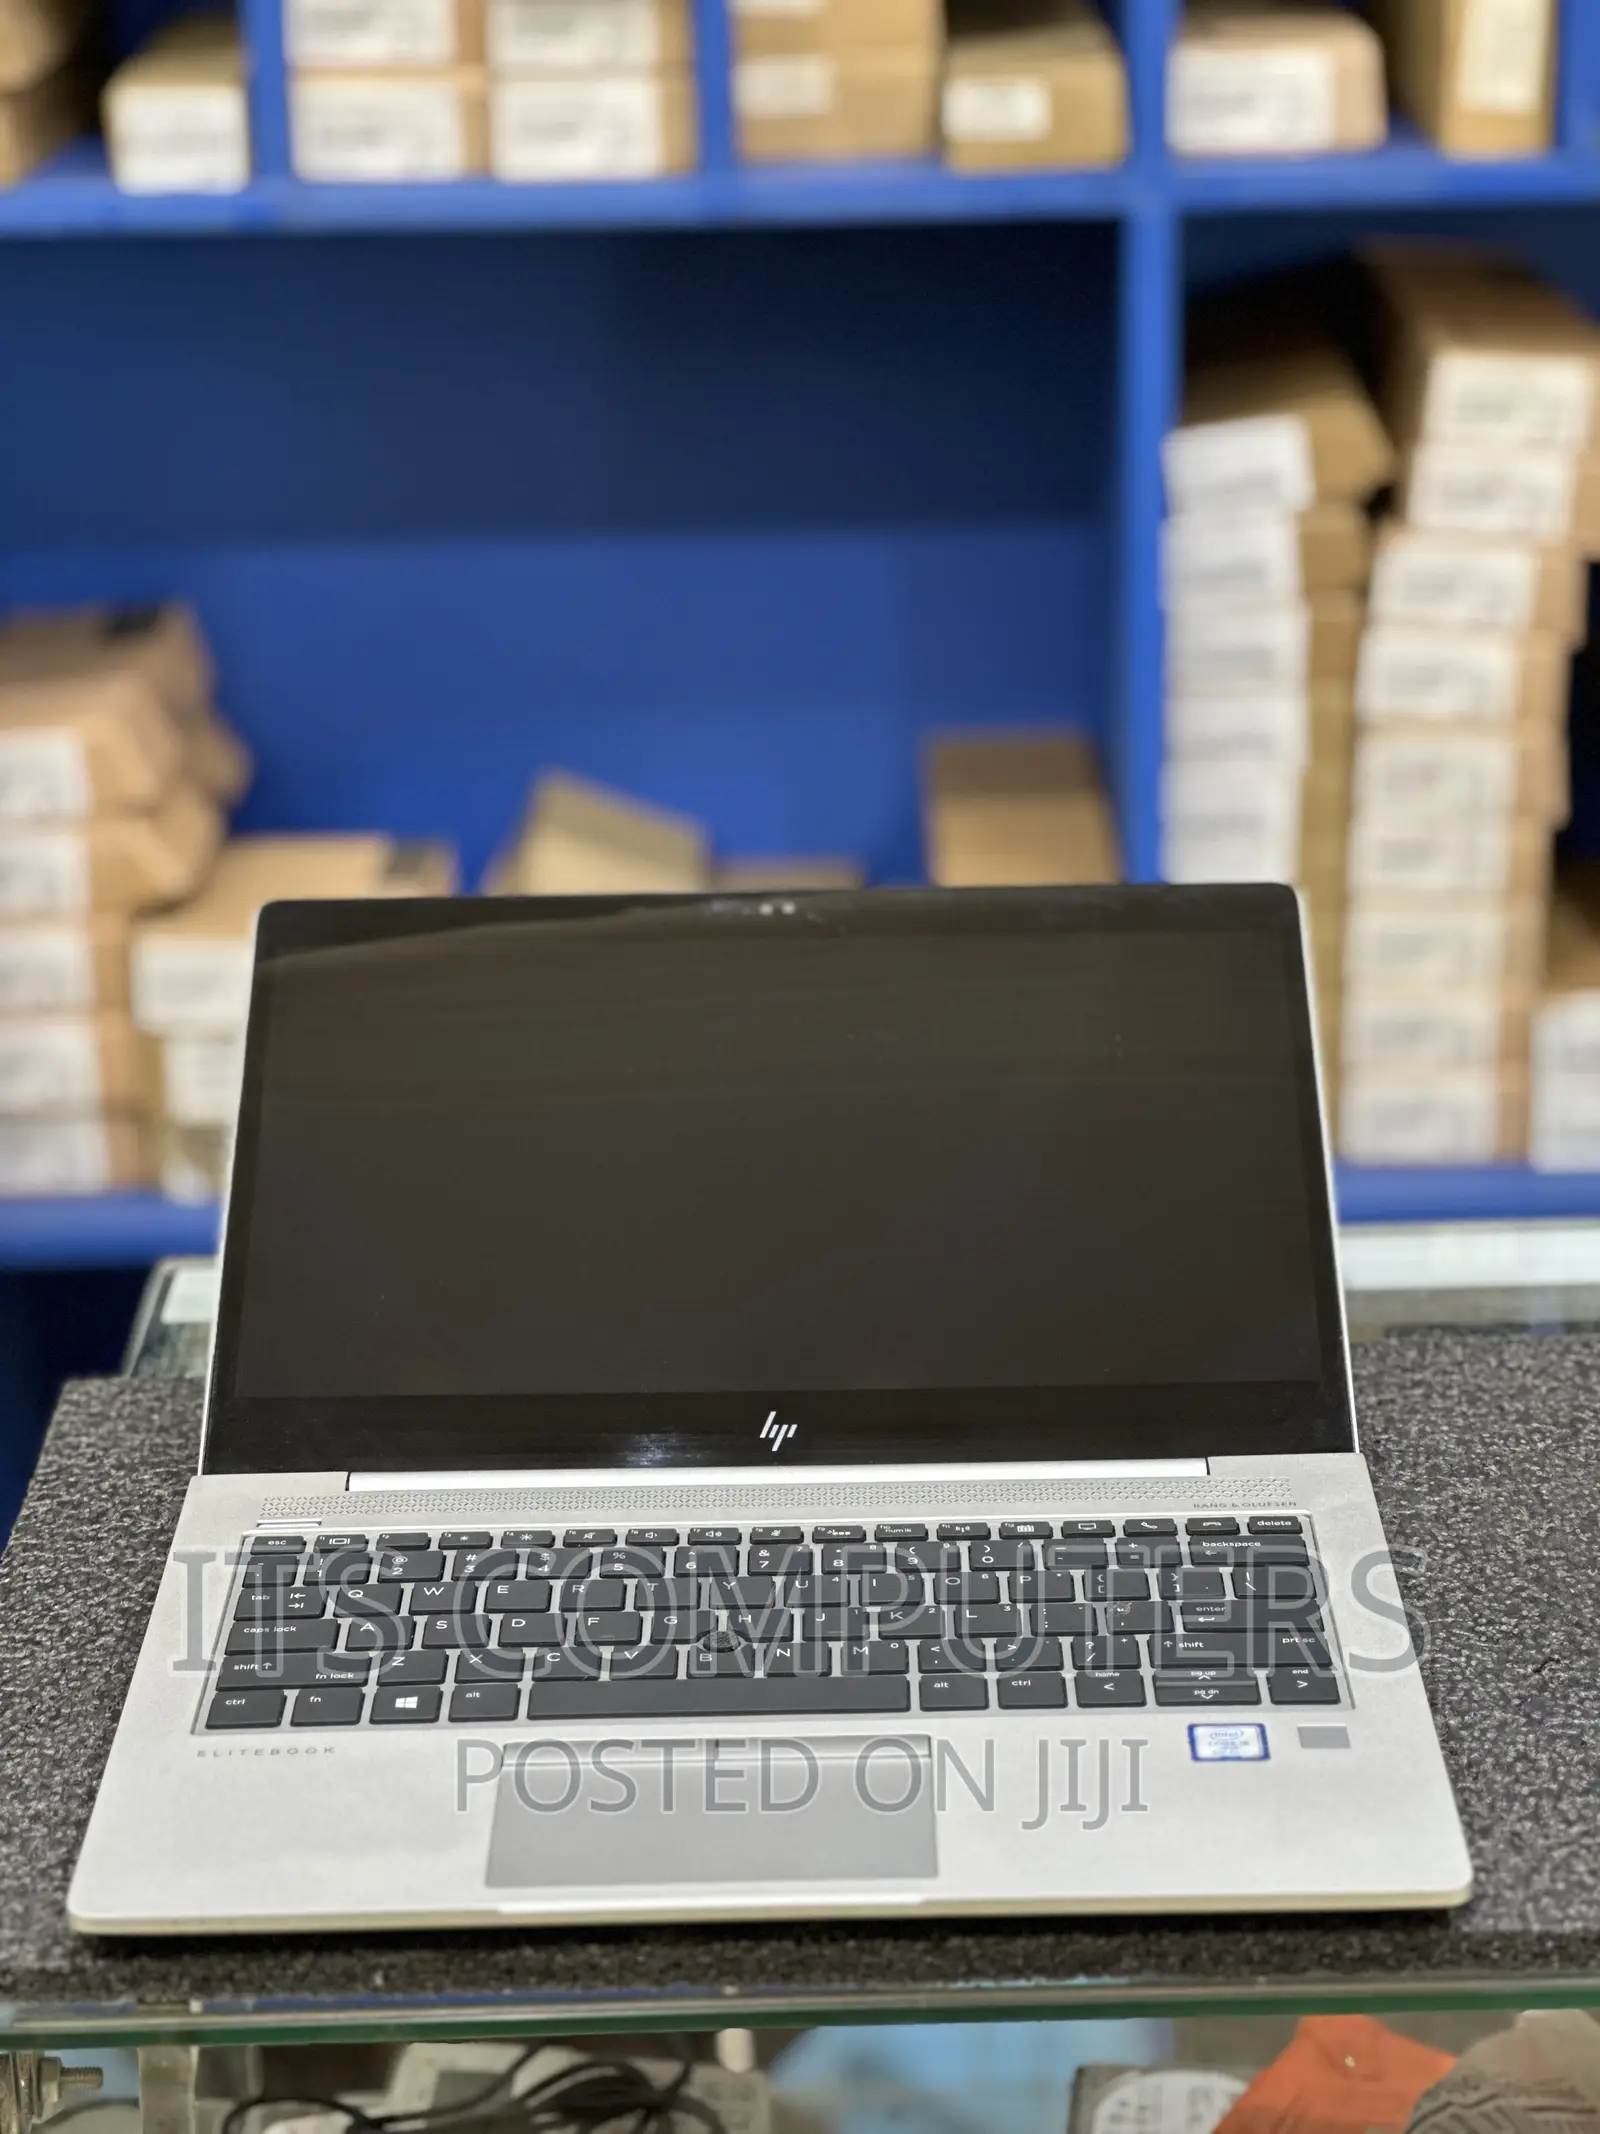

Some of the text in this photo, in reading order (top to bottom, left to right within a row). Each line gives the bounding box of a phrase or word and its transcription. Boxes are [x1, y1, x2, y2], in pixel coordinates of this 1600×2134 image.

[759, 1411, 798, 1452] hp
[613, 1552, 626, 1560] %
[758, 1549, 770, 1557] &
[392, 1555, 408, 1564] @
[465, 1554, 477, 1562] #
[907, 1557, 919, 1565] 9
[613, 1563, 624, 1571] 5
[685, 1562, 697, 1570] 6
[758, 1560, 770, 1569] 7
[833, 1559, 844, 1567] 8
[392, 1567, 403, 1576] 2
[464, 1565, 475, 1573] 3
[538, 1565, 550, 1573] 4
[795, 1580, 809, 1588] U
[944, 1577, 961, 1586] O
[1019, 1575, 1032, 1584] P
[497, 1585, 510, 1594] E
[572, 1584, 585, 1593] R
[647, 1582, 659, 1592] T
[722, 1581, 736, 1590] Y
[348, 1589, 364, 1599] Q
[423, 1586, 444, 1596] W
[816, 1613, 826, 1622] J
[890, 1611, 904, 1620] K
[966, 1609, 977, 1618] L
[511, 1618, 526, 1628] D
[587, 1617, 600, 1626] F
[663, 1616, 678, 1625] G
[738, 1615, 752, 1623] H
[243, 1625, 297, 1634] caps lock
[360, 1622, 375, 1632] A
[435, 1620, 448, 1630] S
[1178, 1641, 1204, 1649] shift
[776, 1648, 791, 1657] N
[853, 1646, 869, 1655] M
[469, 1654, 483, 1664] X
[546, 1652, 561, 1662] C
[624, 1651, 639, 1660] V
[700, 1653, 713, 1662] B
[391, 1656, 406, 1666] Z
[233, 1663, 259, 1671] shift
[315, 1672, 327, 1680] fn
[1011, 1679, 1032, 1687] ctrl
[225, 1698, 246, 1706] ctrl
[309, 1695, 322, 1703] fn
[197, 1746, 336, 1758] ELITEBOOK
